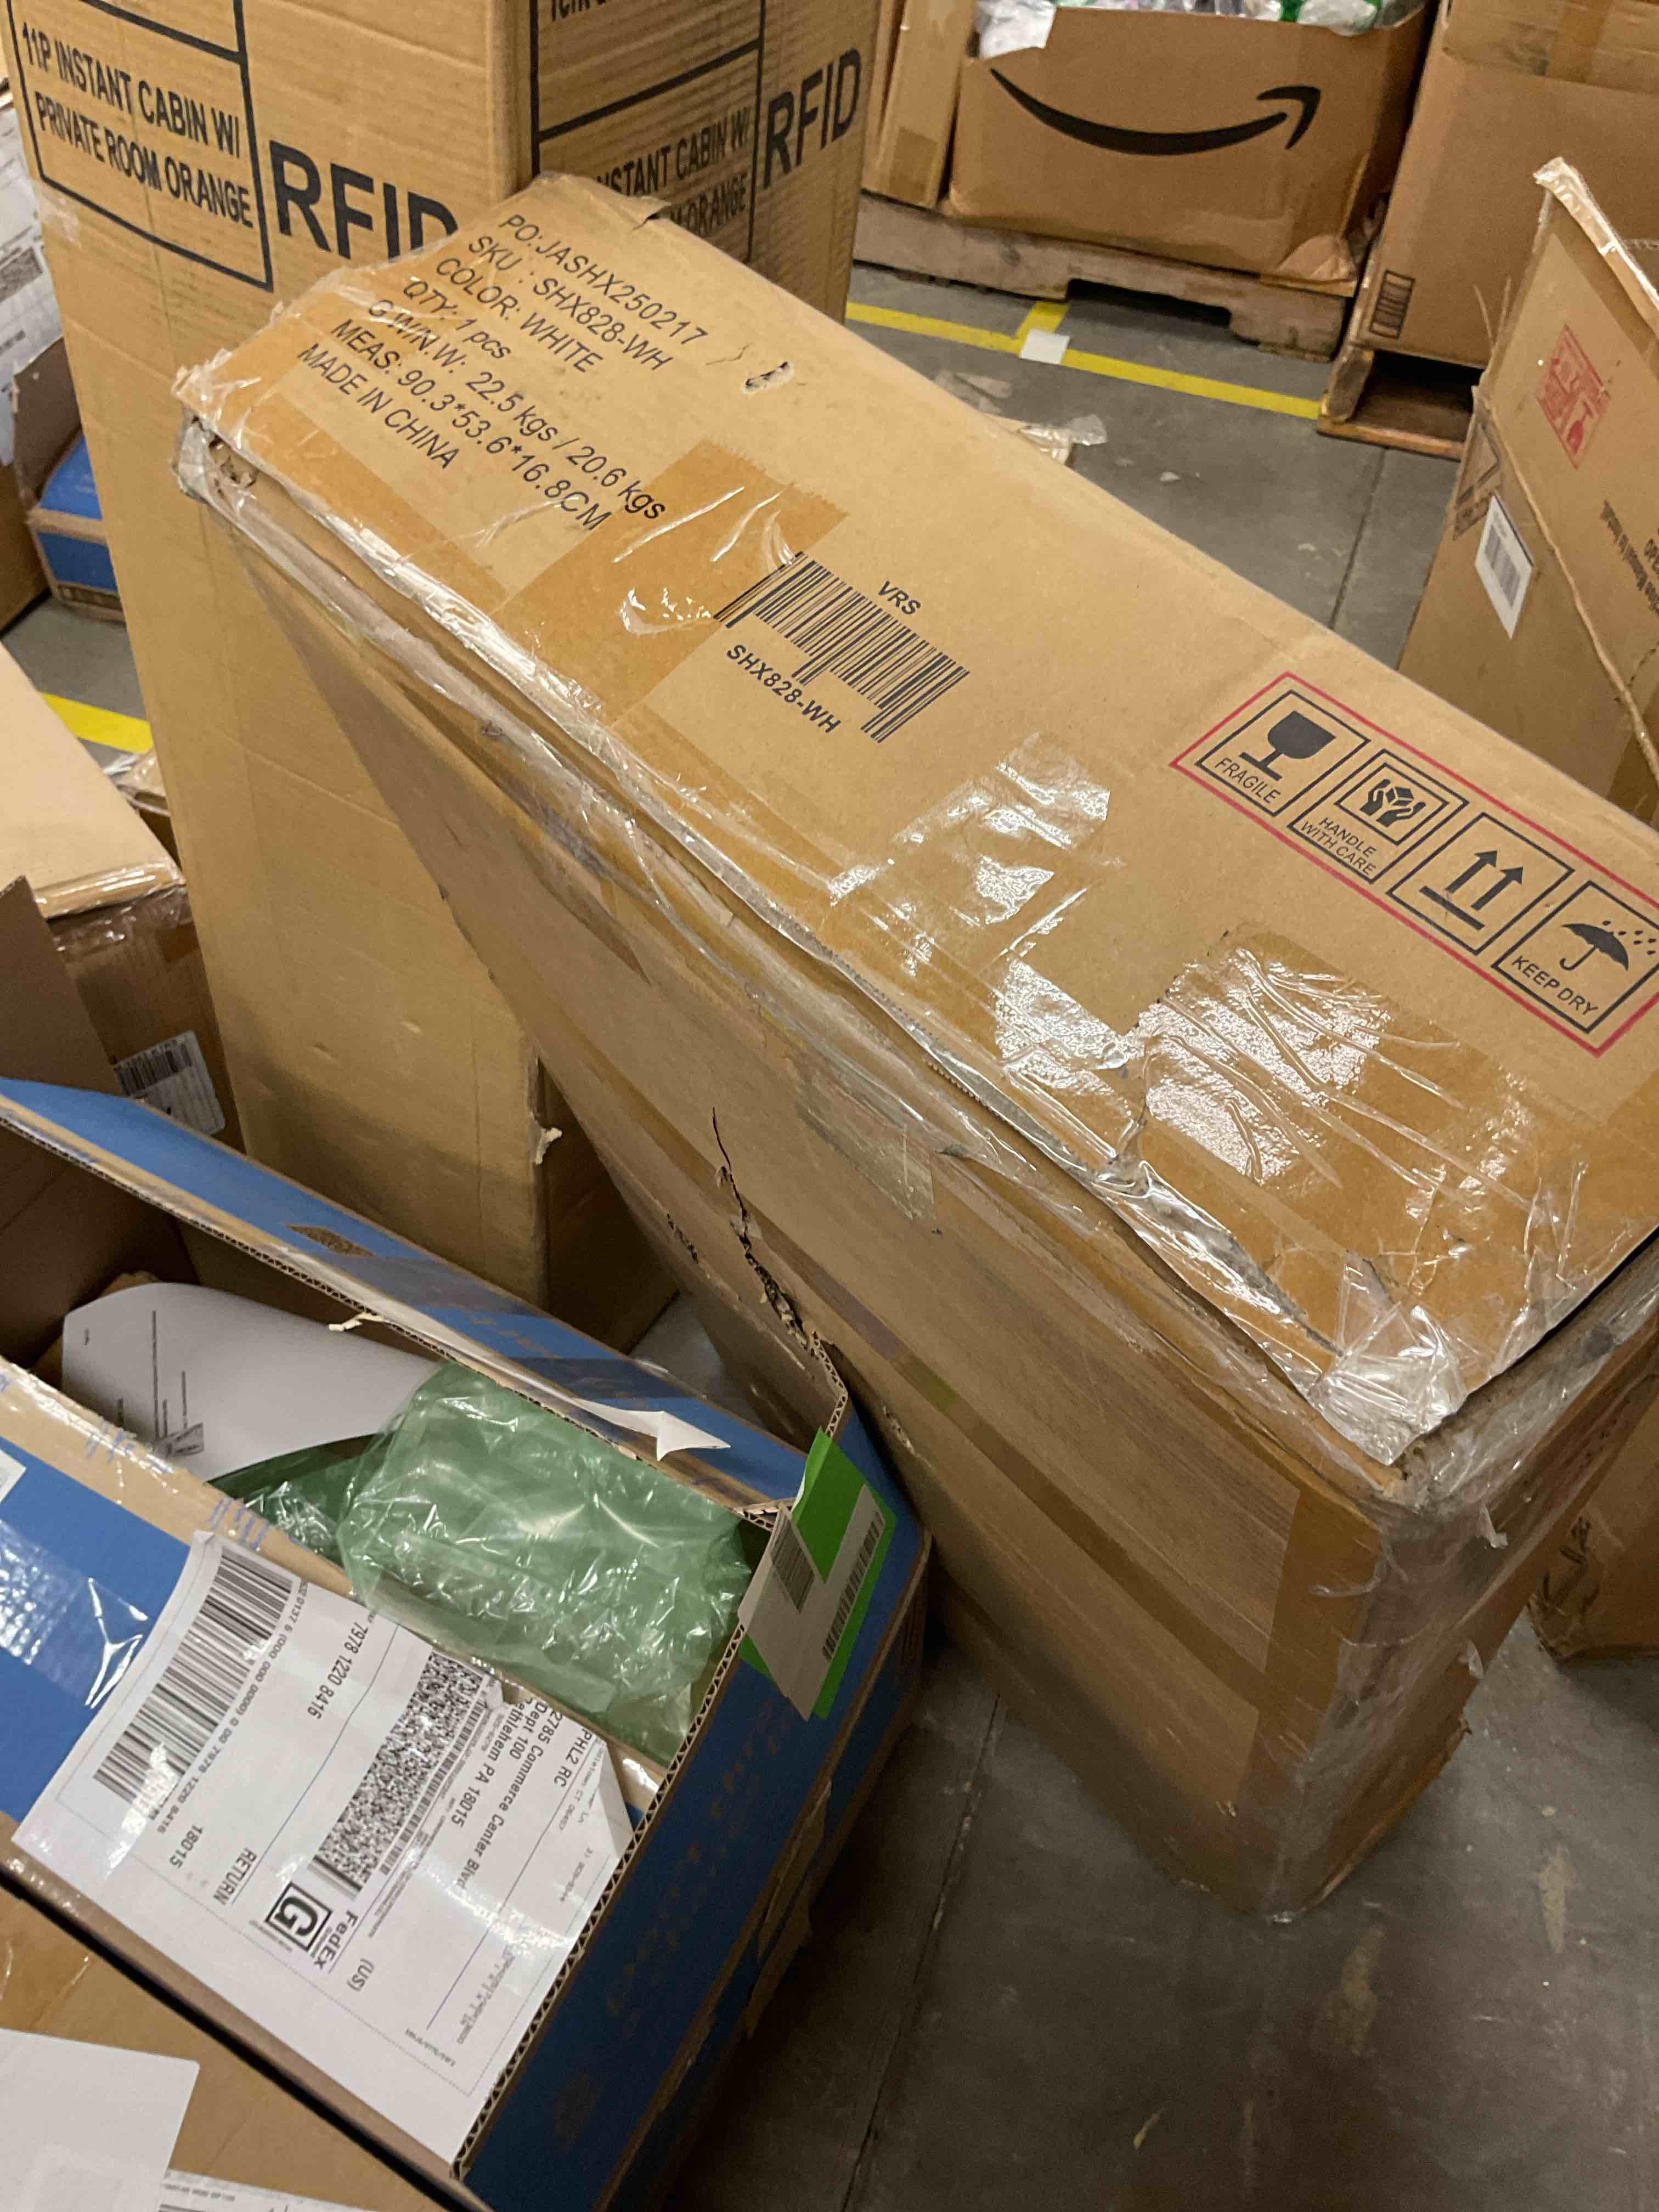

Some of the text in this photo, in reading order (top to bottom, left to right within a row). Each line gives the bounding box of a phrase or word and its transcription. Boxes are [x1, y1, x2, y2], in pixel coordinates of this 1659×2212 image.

[22, 22, 51, 72] 11P
[55, 39, 132, 115] INSTANT
[139, 80, 208, 145] CABIN
[676, 116, 727, 181] CABIN
[764, 48, 862, 189] RFID
[35, 91, 253, 229] PRIVATE ROOM ORANGE
[269, 140, 458, 263] RFID
[403, 280, 511, 359] QTY: 1 pcs
[436, 258, 603, 373] COLOR: WHITE
[469, 236, 522, 271] SKU
[533, 278, 674, 371] SHX828-WH
[330, 319, 402, 374] MEAS:
[297, 343, 461, 469] MADE IN CHINA
[466, 371, 522, 413] 22.5
[514, 405, 559, 442] kgs
[552, 437, 580, 450] /
[567, 446, 628, 488] 20.6
[618, 481, 666, 520] kgs
[878, 580, 921, 615] VRS
[726, 645, 842, 733] SHX828-WH
[1214, 757, 1280, 805] FRAGILE
[1301, 821, 1377, 876] WITH CARE
[1318, 817, 1377, 857] HANDLE
[1511, 955, 1599, 1017] KEEP DRY
[308, 1622, 368, 1719] 7978 1220 8416
[509, 1702, 547, 1760] Dept 100
[554, 1729, 592, 1787] PHL2 RC
[456, 1710, 562, 1889] 2785 Commerce Center Blvd
[475, 1763, 495, 1784] PA
[452, 1786, 480, 1828] 18015
[170, 1825, 204, 1869] 18015
[213, 1847, 257, 1905] RETURN
[274, 1896, 318, 1937] G
[314, 1911, 359, 1970] FedEx
[347, 1959, 375, 1991] (US)
